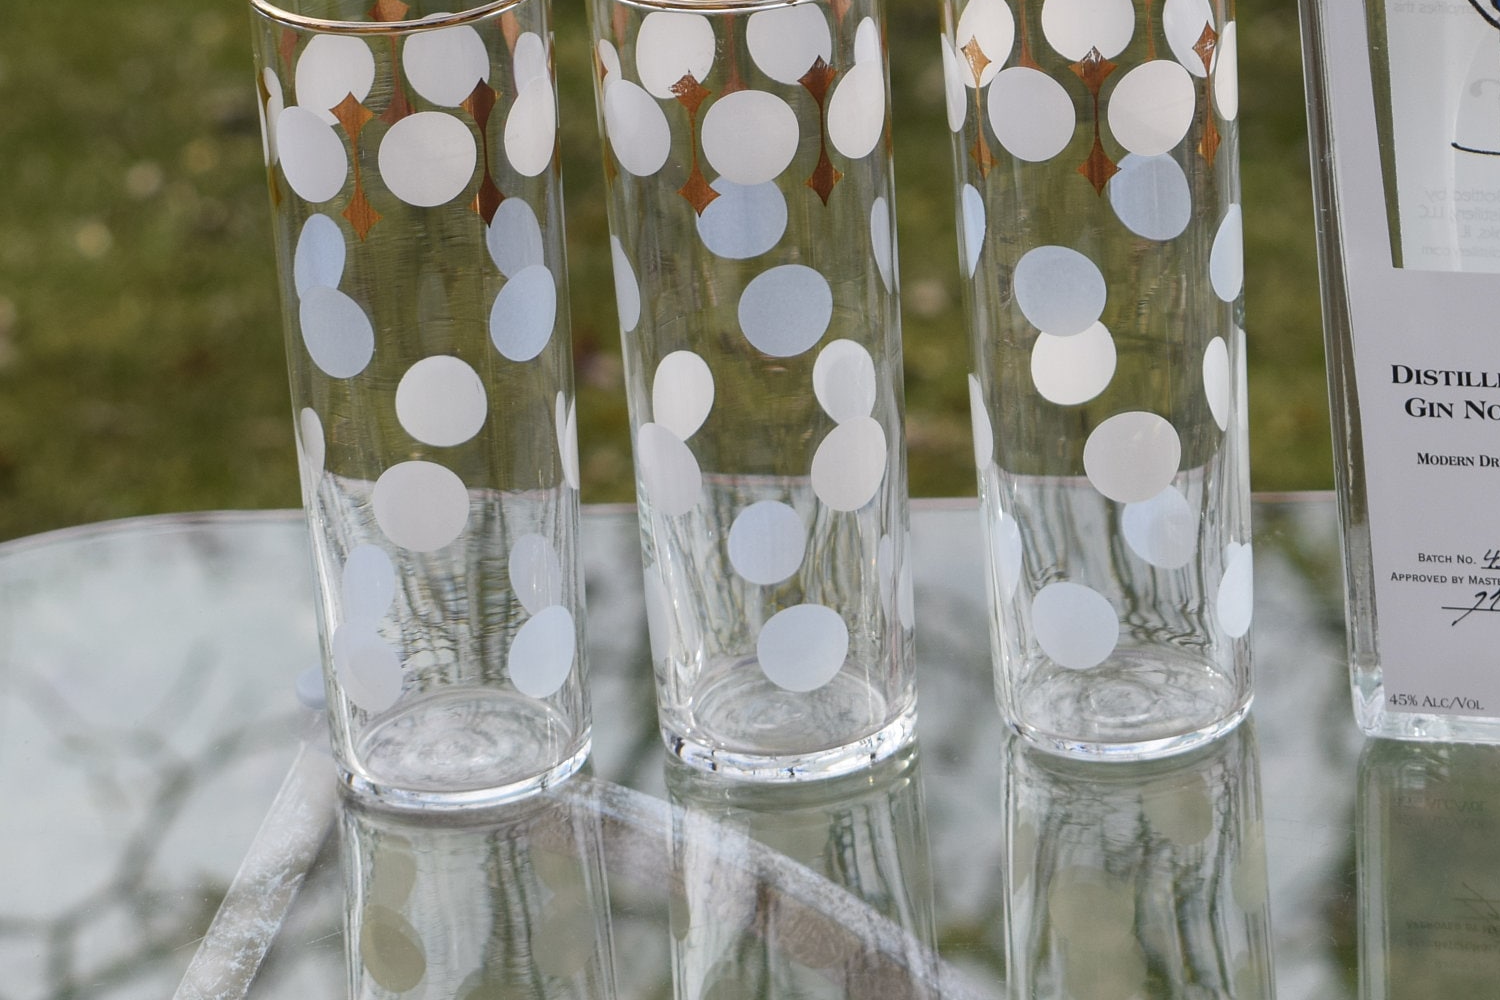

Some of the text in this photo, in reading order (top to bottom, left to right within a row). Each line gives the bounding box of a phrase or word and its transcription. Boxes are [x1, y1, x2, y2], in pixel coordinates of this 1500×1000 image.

[1404, 397, 1453, 418] GIN
[1417, 452, 1475, 467] MODERN
[1418, 553, 1452, 563] BATCH
[1390, 572, 1448, 584] APPROVED
[1451, 575, 1464, 584] BY
[1389, 693, 1418, 706] 45%
